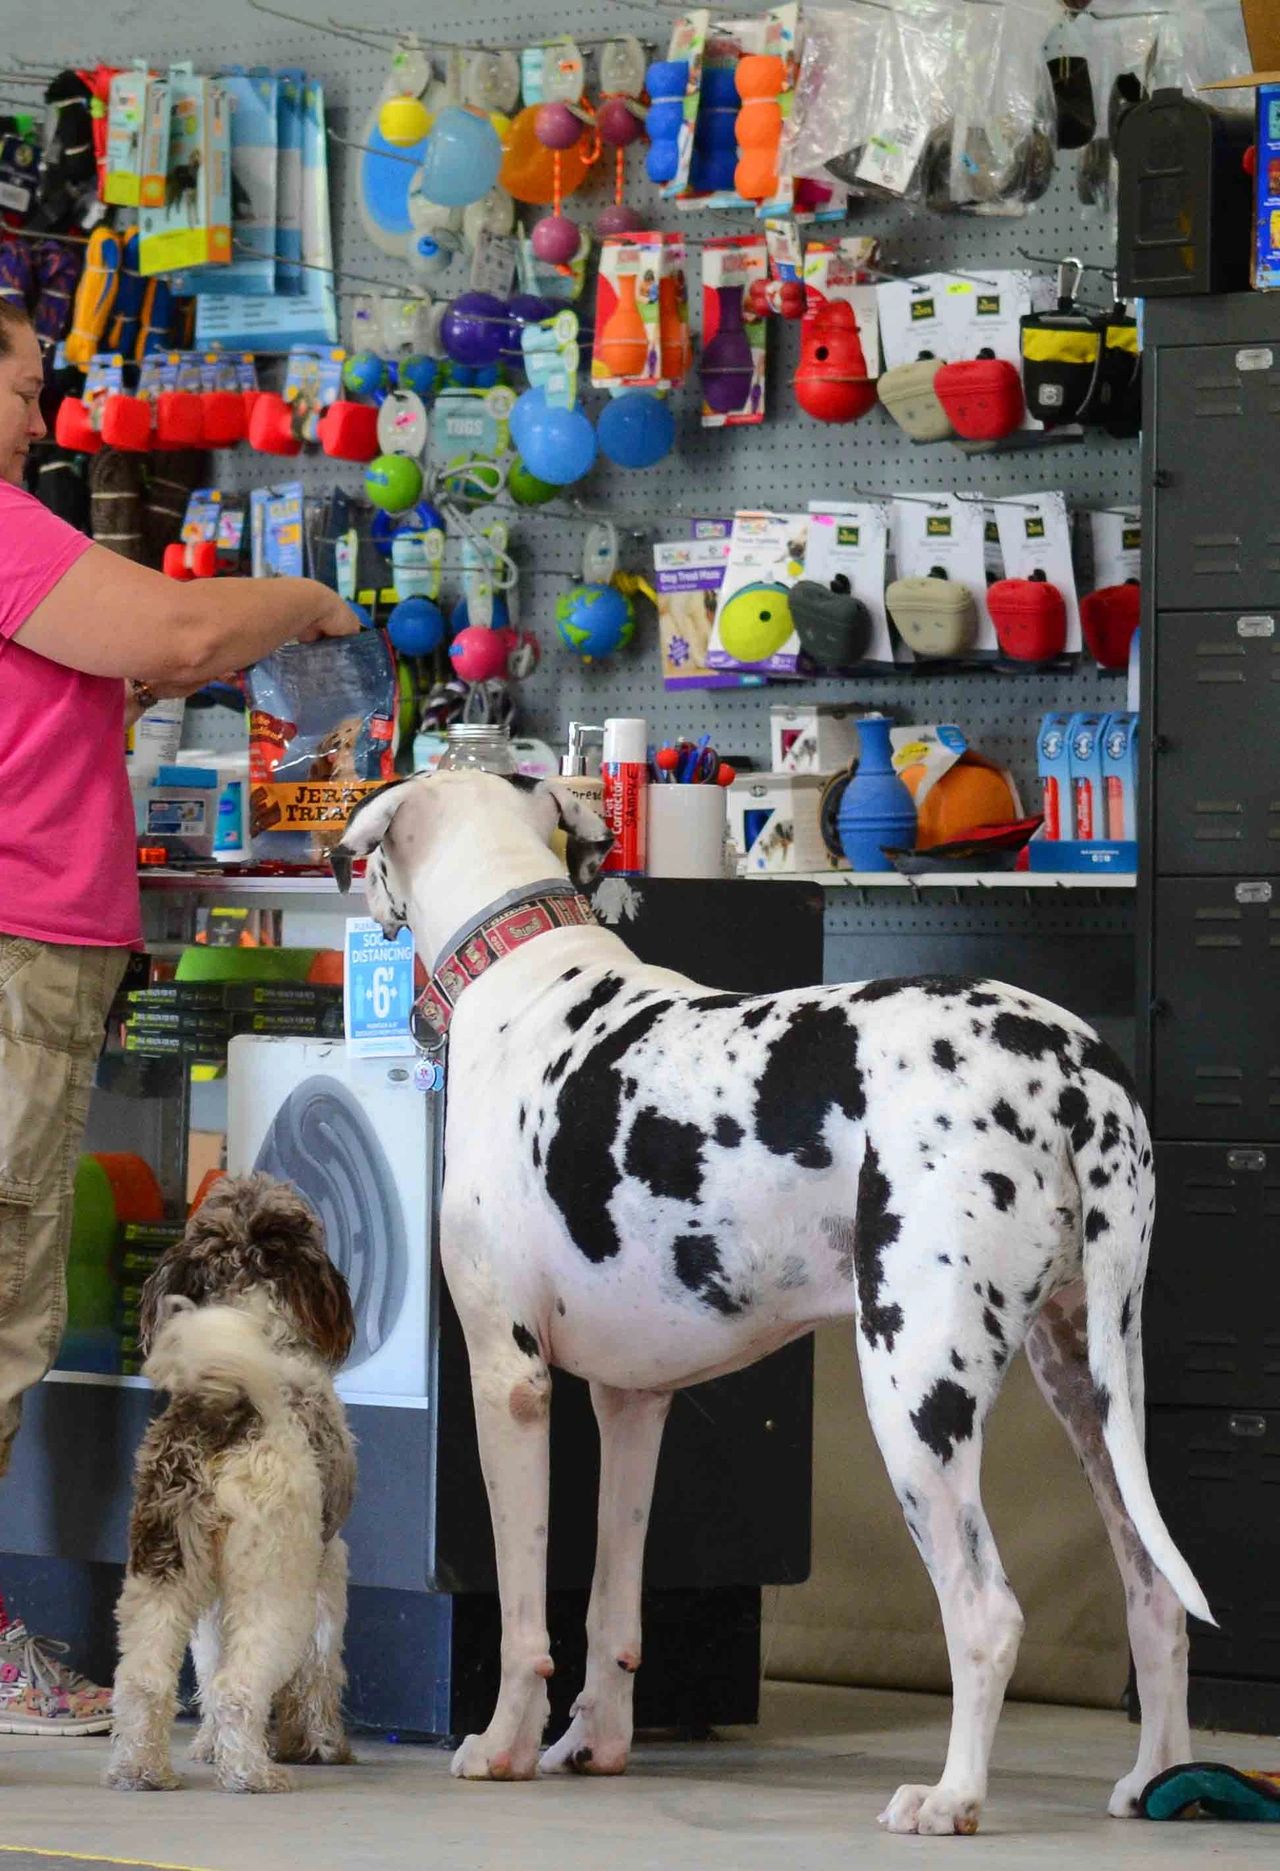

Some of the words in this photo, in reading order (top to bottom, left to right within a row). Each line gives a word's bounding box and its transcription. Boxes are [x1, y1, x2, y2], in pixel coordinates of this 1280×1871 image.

[604, 797, 614, 818] Pet
[612, 779, 624, 835] Corrector
[352, 947, 412, 963] DISTANCING
